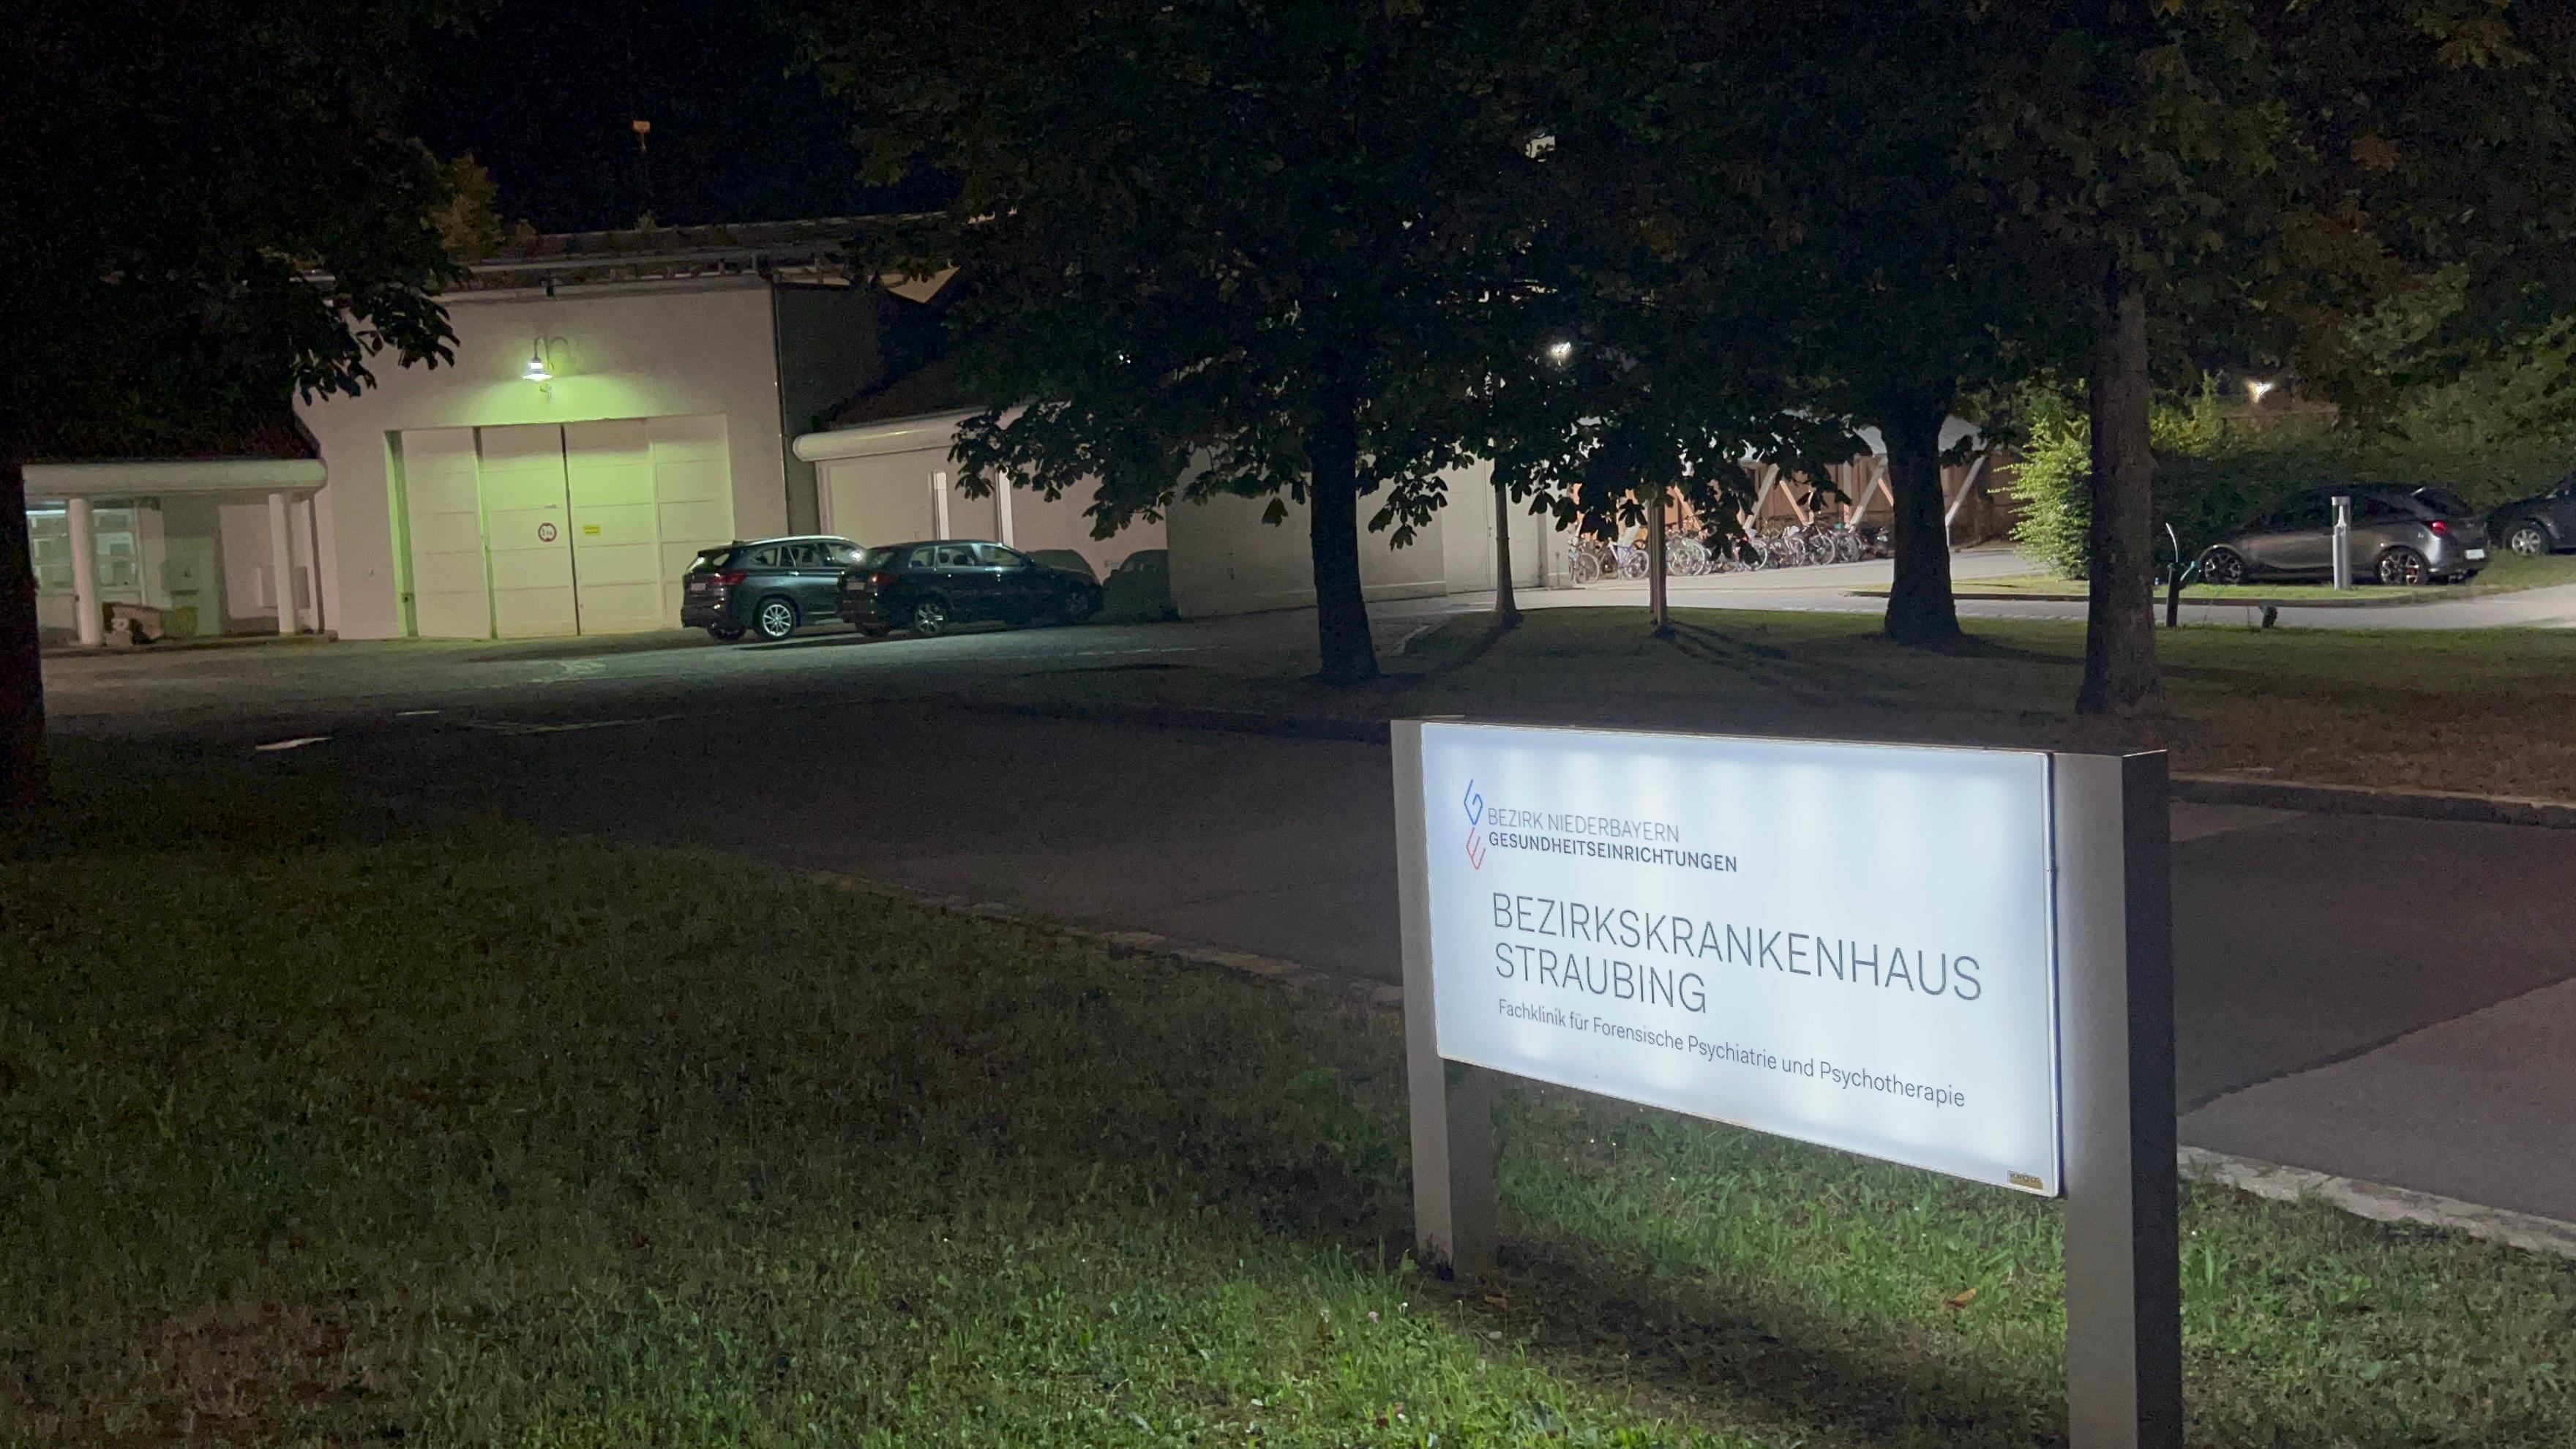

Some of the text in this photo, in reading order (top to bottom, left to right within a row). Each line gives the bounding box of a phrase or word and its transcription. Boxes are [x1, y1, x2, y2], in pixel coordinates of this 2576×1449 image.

[1489, 807, 1679, 844] BEZIRK NIEDERBAYERN
[1489, 831, 1737, 873] GESUNDHEITSEINRICHTUNGEN
[1492, 891, 1982, 1001] BEZIRKSKRANKENHAUS
[1495, 942, 1707, 1014] STRAUBING
[1499, 998, 1965, 1109] Fachklinik für Forensische Psychiatrie und Psychotherapie
